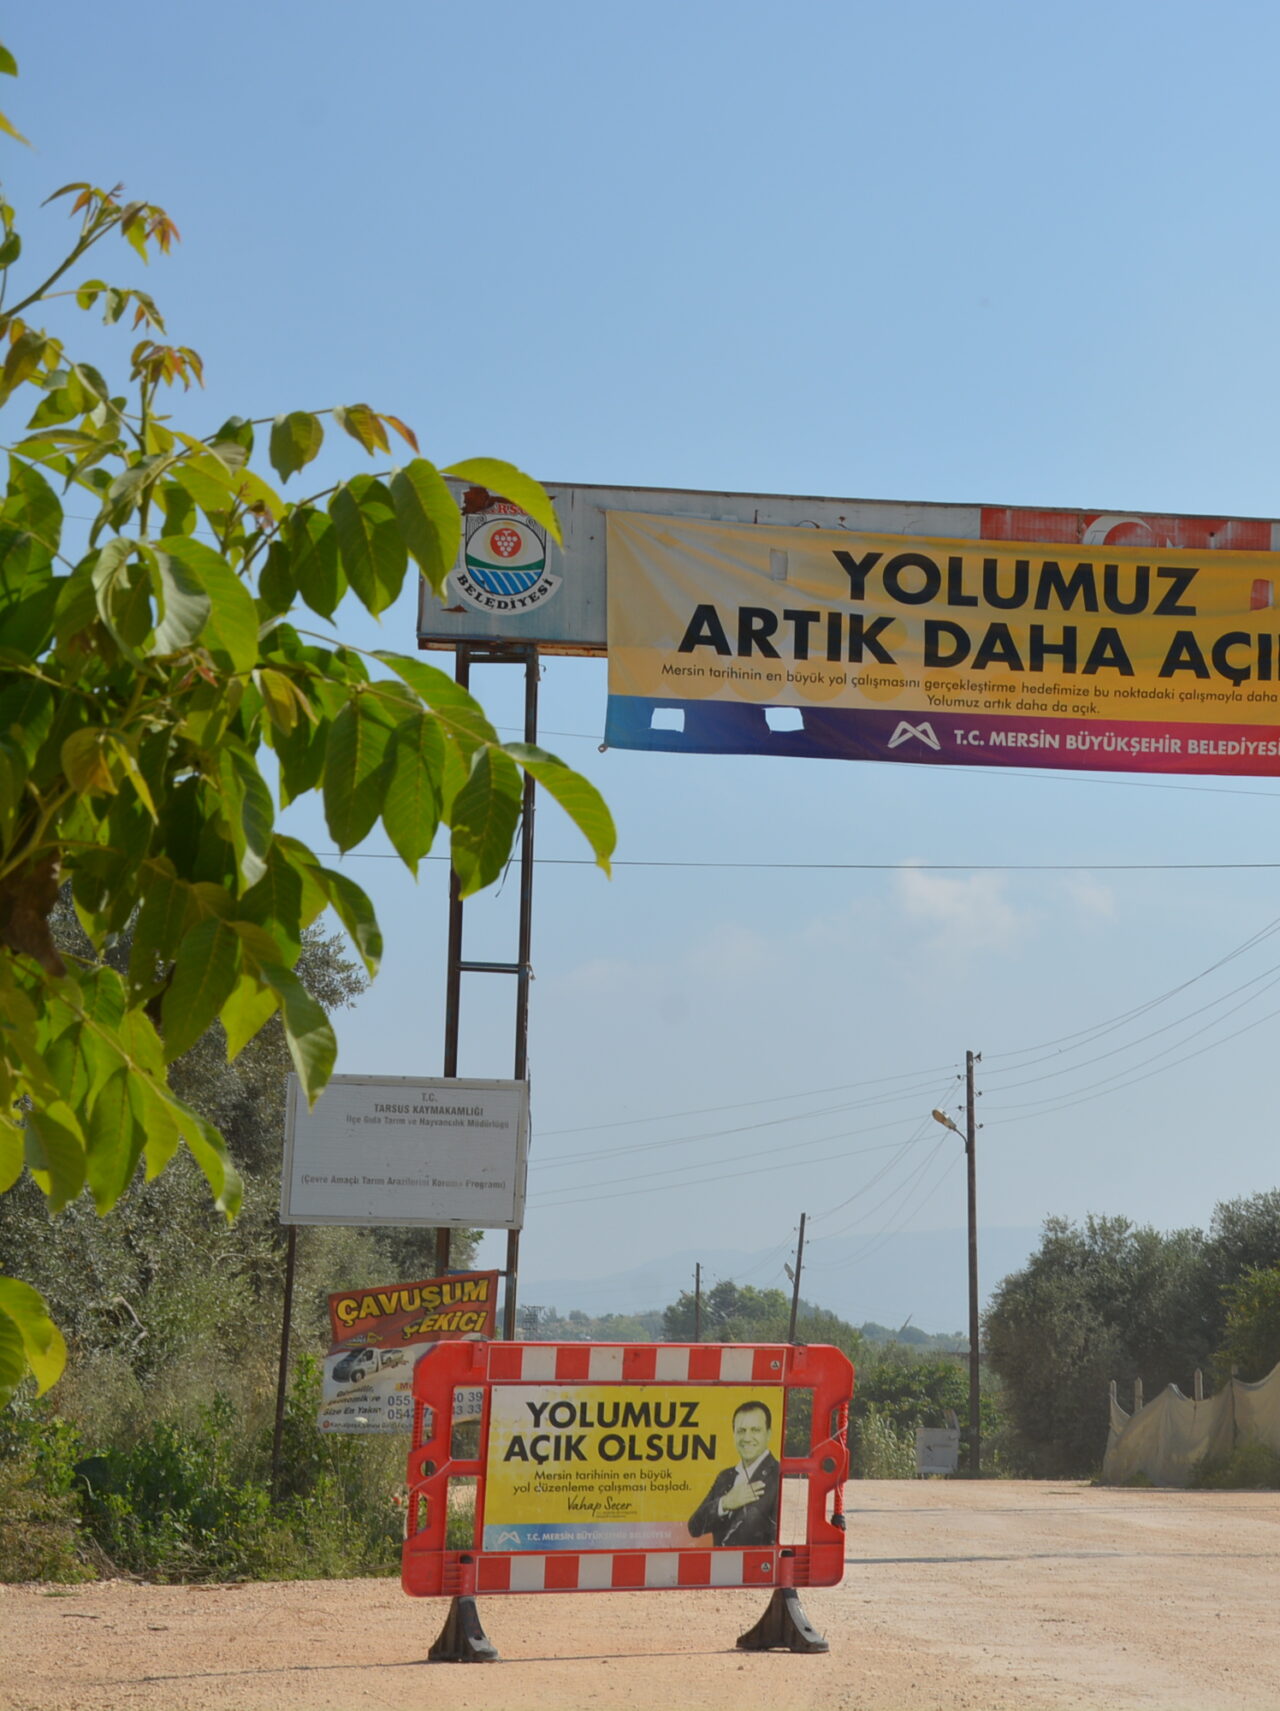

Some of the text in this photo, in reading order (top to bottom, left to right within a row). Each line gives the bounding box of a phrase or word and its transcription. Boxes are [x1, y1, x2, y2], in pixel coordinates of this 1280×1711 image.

[457, 574, 554, 610] BELEDİYESİ
[832, 550, 1199, 616] YOLUMUZ
[678, 604, 897, 666] ARTIK
[924, 620, 1135, 676] DAHA
[661, 664, 705, 676] Mersin
[709, 667, 762, 680] tarihinin
[766, 672, 782, 681] en
[787, 670, 824, 685] büyük
[829, 671, 847, 686] yol
[852, 673, 920, 688] çalışmasını
[924, 679, 1016, 693] gerçekleştirme
[1021, 683, 1090, 697] hedefimize
[1094, 686, 1110, 698] bu
[1114, 687, 1175, 699] noktadaki
[1178, 689, 1242, 703] çalışmayla
[1247, 691, 1277, 702] daha
[927, 694, 1100, 715] Yolumuz artık daha da açık.
[954, 729, 985, 746] T.C.
[989, 729, 1059, 748] MERSİN
[1066, 730, 1182, 756] BÜYÜKŞEHİR
[421, 1092, 438, 1102] T.C.
[374, 1104, 484, 1116] TARSUS KAYMAKAMLIĞI
[336, 1279, 489, 1327] ÇAVUŞUM
[388, 1395, 414, 1406] 055
[526, 1401, 700, 1428] YOLUMUZ
[503, 1434, 717, 1465] AÇIK OLSUN
[513, 1480, 692, 1495] yol düzenleme çalışması başladı.
[534, 1469, 672, 1483] Mersin tarihinin en büyük
[567, 1496, 632, 1517] Vahap Seçer
[527, 1532, 541, 1541] T.C.
[542, 1530, 574, 1541] MERSİN
